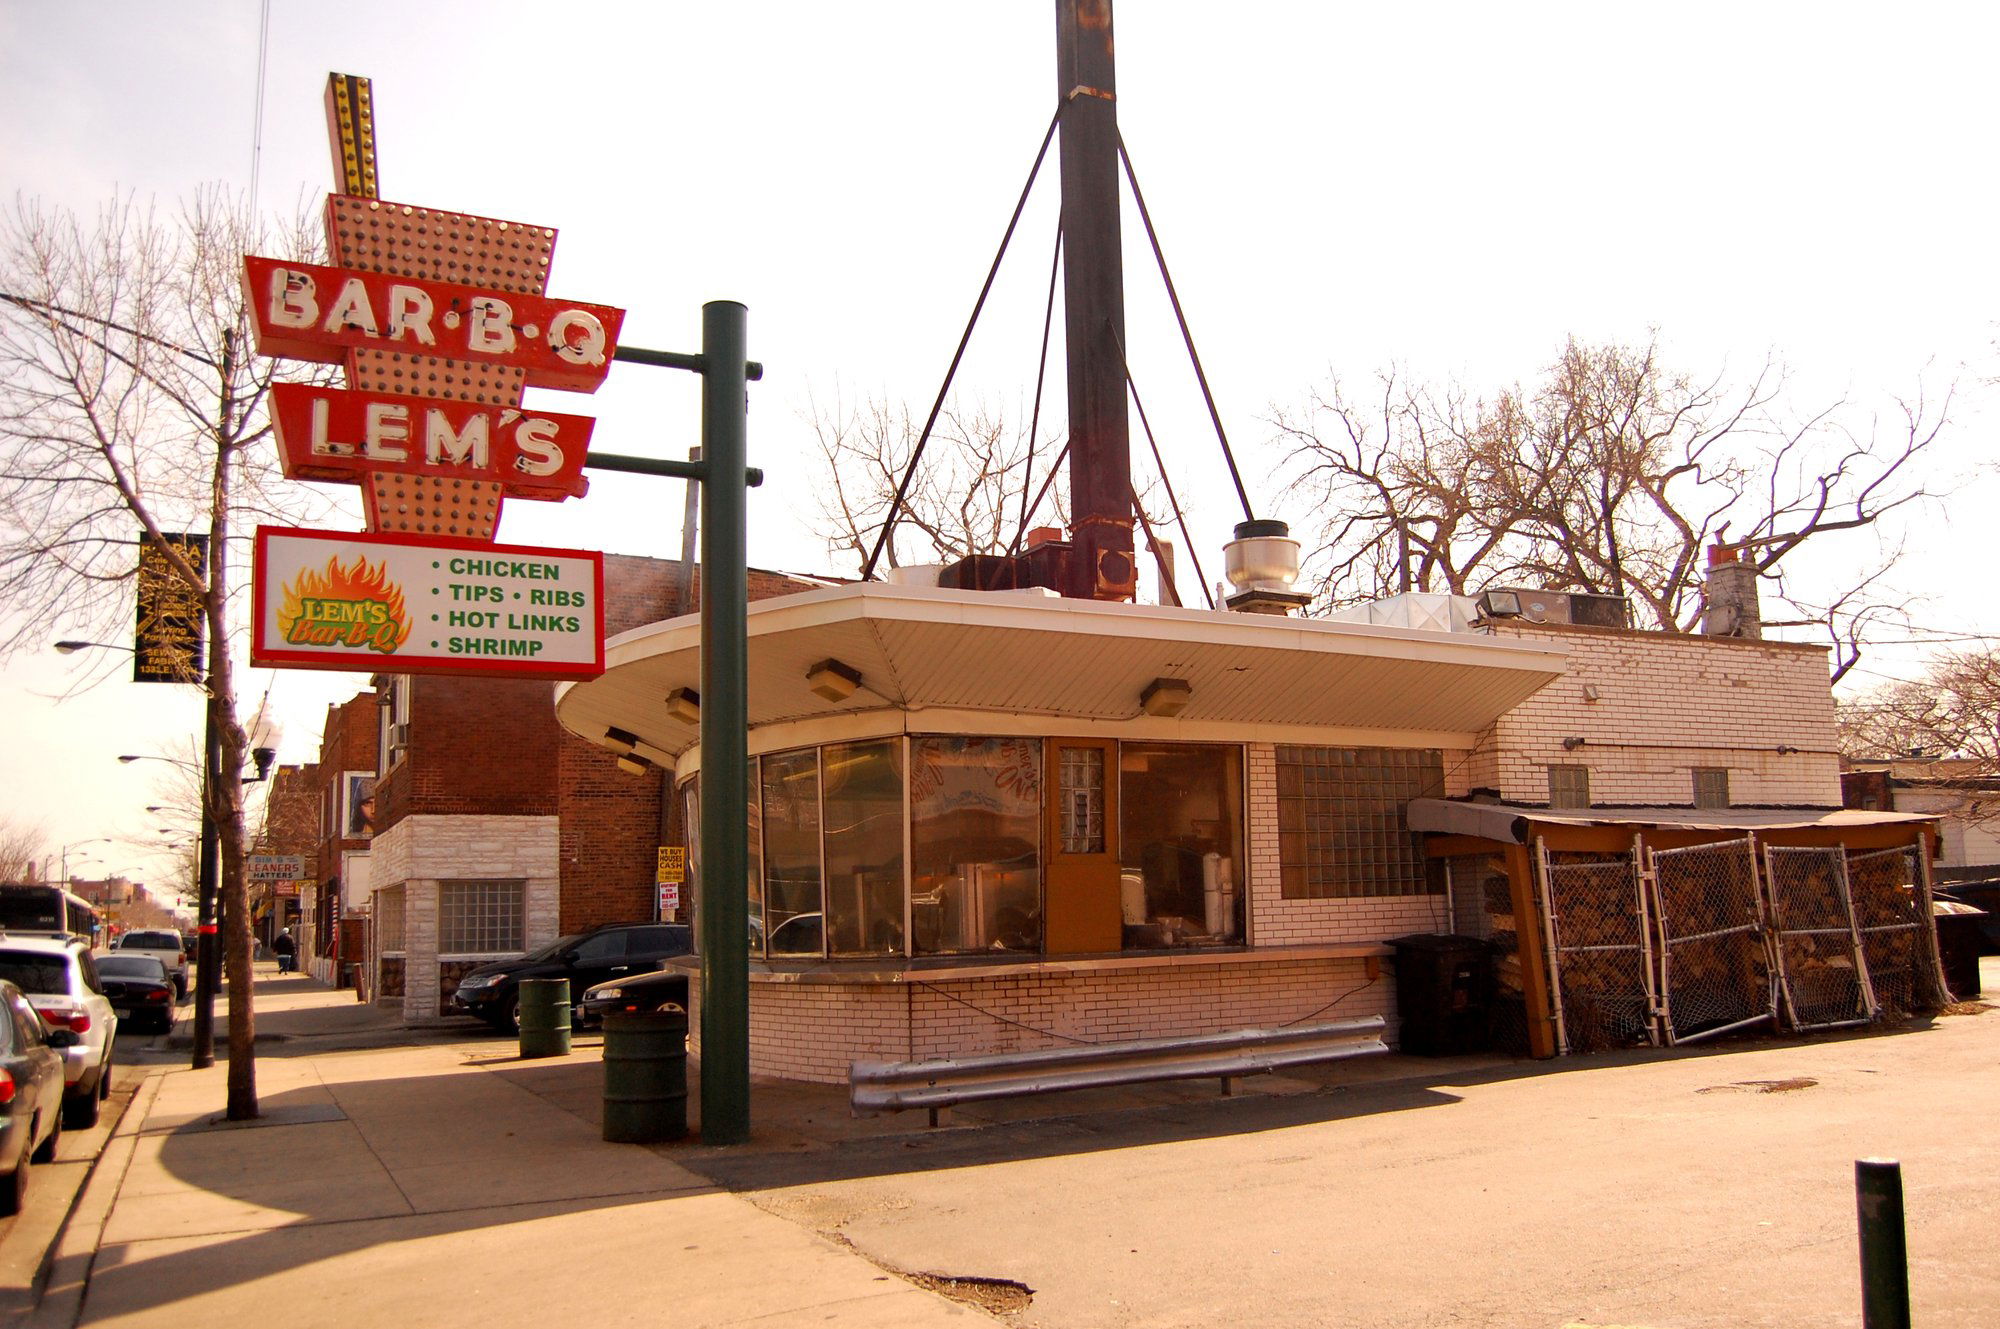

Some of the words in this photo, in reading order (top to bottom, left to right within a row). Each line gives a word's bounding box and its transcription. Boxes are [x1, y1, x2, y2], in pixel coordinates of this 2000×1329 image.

[311, 398, 565, 477] LEM'S
[449, 558, 560, 580] CHICKEN
[449, 584, 504, 603] TIPS
[530, 589, 586, 607] RIBS
[303, 600, 389, 624] LEM'S
[449, 611, 498, 629] HOT
[508, 614, 581, 633] LINKS
[290, 618, 398, 653] Bar-B-Q
[449, 637, 543, 656] SHRIMP
